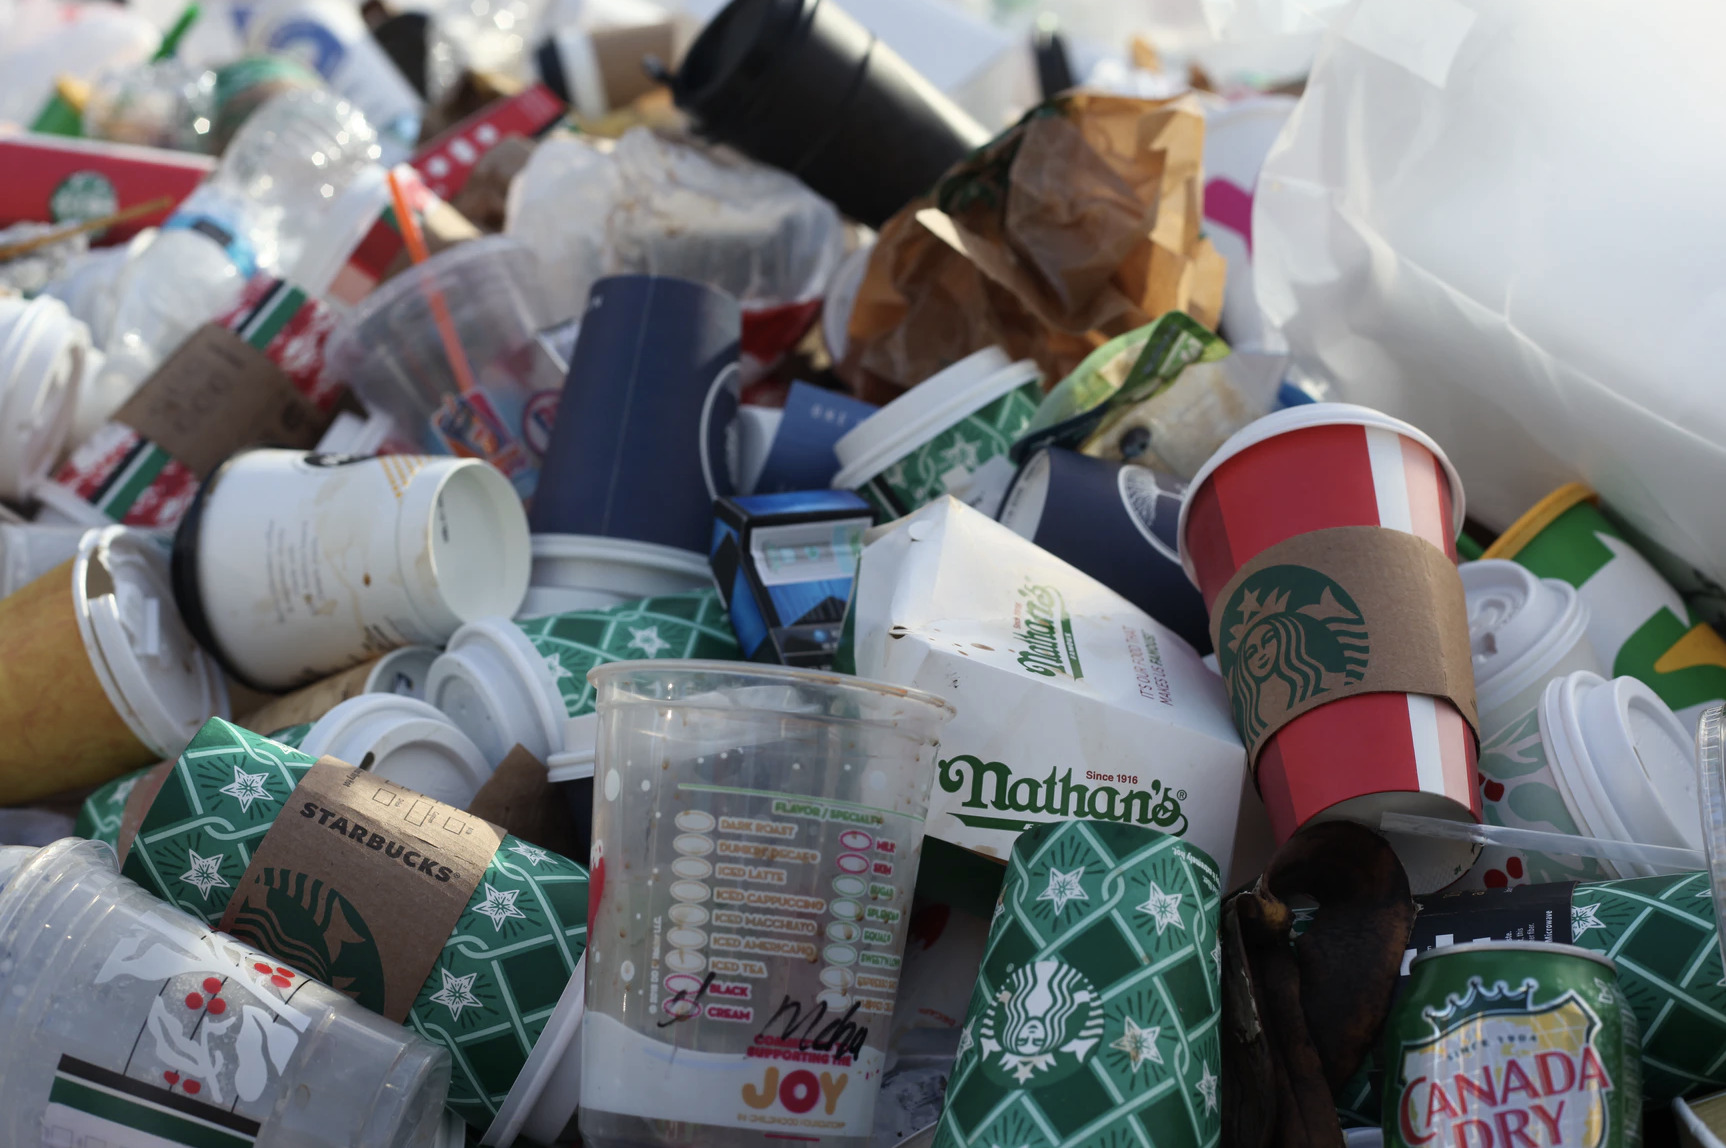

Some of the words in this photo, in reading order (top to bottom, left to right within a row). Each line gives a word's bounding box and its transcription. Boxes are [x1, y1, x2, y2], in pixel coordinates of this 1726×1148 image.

[1127, 645, 1145, 666] FOOD
[1134, 665, 1150, 685] OUR
[1150, 664, 1167, 679] US
[1138, 684, 1154, 700] IT'S
[1154, 676, 1174, 707] MAKES
[1086, 770, 1114, 782] Since
[1116, 773, 1139, 785] 1916
[720, 818, 752, 834] DARK
[755, 822, 796, 837] ROAST
[718, 866, 746, 879] ICED
[748, 868, 785, 882] LATTE
[716, 889, 744, 903] ICED
[747, 892, 825, 912] CAPPUCCINO
[714, 912, 743, 926] ICED
[745, 915, 816, 933] MACCHIATO
[712, 936, 742, 949] ICED
[743, 938, 817, 957] AMERICANO
[711, 959, 740, 973] ICED
[742, 961, 766, 976] TEA
[708, 982, 750, 998] BLACK
[706, 1006, 751, 1023] CREAM
[746, 1045, 829, 1065] SUPPORTING
[1446, 1039, 1490, 1061] SINCE
[1497, 1033, 1538, 1044] 1904
[741, 1066, 849, 1116] JOY
[1399, 1045, 1611, 1147] CANADA
[1451, 1099, 1567, 1148] DRY
